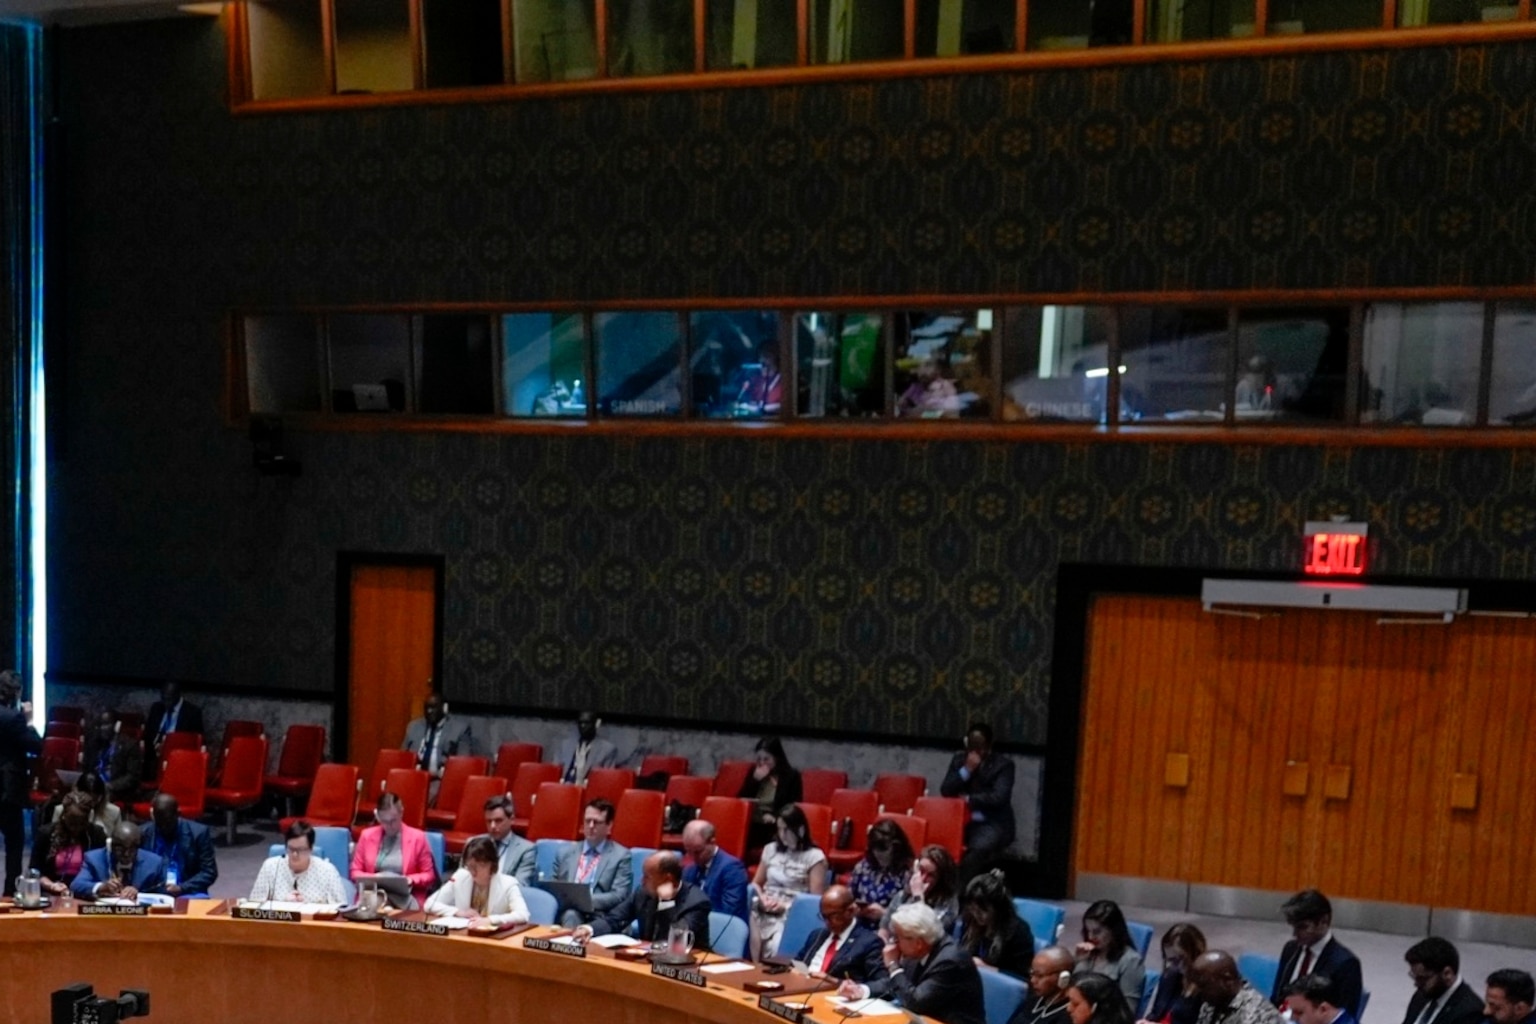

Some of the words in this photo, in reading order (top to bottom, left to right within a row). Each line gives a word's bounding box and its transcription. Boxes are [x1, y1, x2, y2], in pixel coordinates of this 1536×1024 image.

[611, 400, 665, 413] SPANISH
[1026, 402, 1092, 417] CHINESE
[1312, 534, 1360, 567] EXIT
[82, 905, 112, 914] SIERRA
[116, 905, 144, 914] LEONE
[240, 909, 292, 919] SLOVENIA
[384, 920, 445, 934] SWITZERLAND
[524, 937, 549, 949] UNITED
[551, 943, 583, 955] KINGDOM
[652, 963, 677, 978] UNITED
[677, 970, 704, 985] STATES
